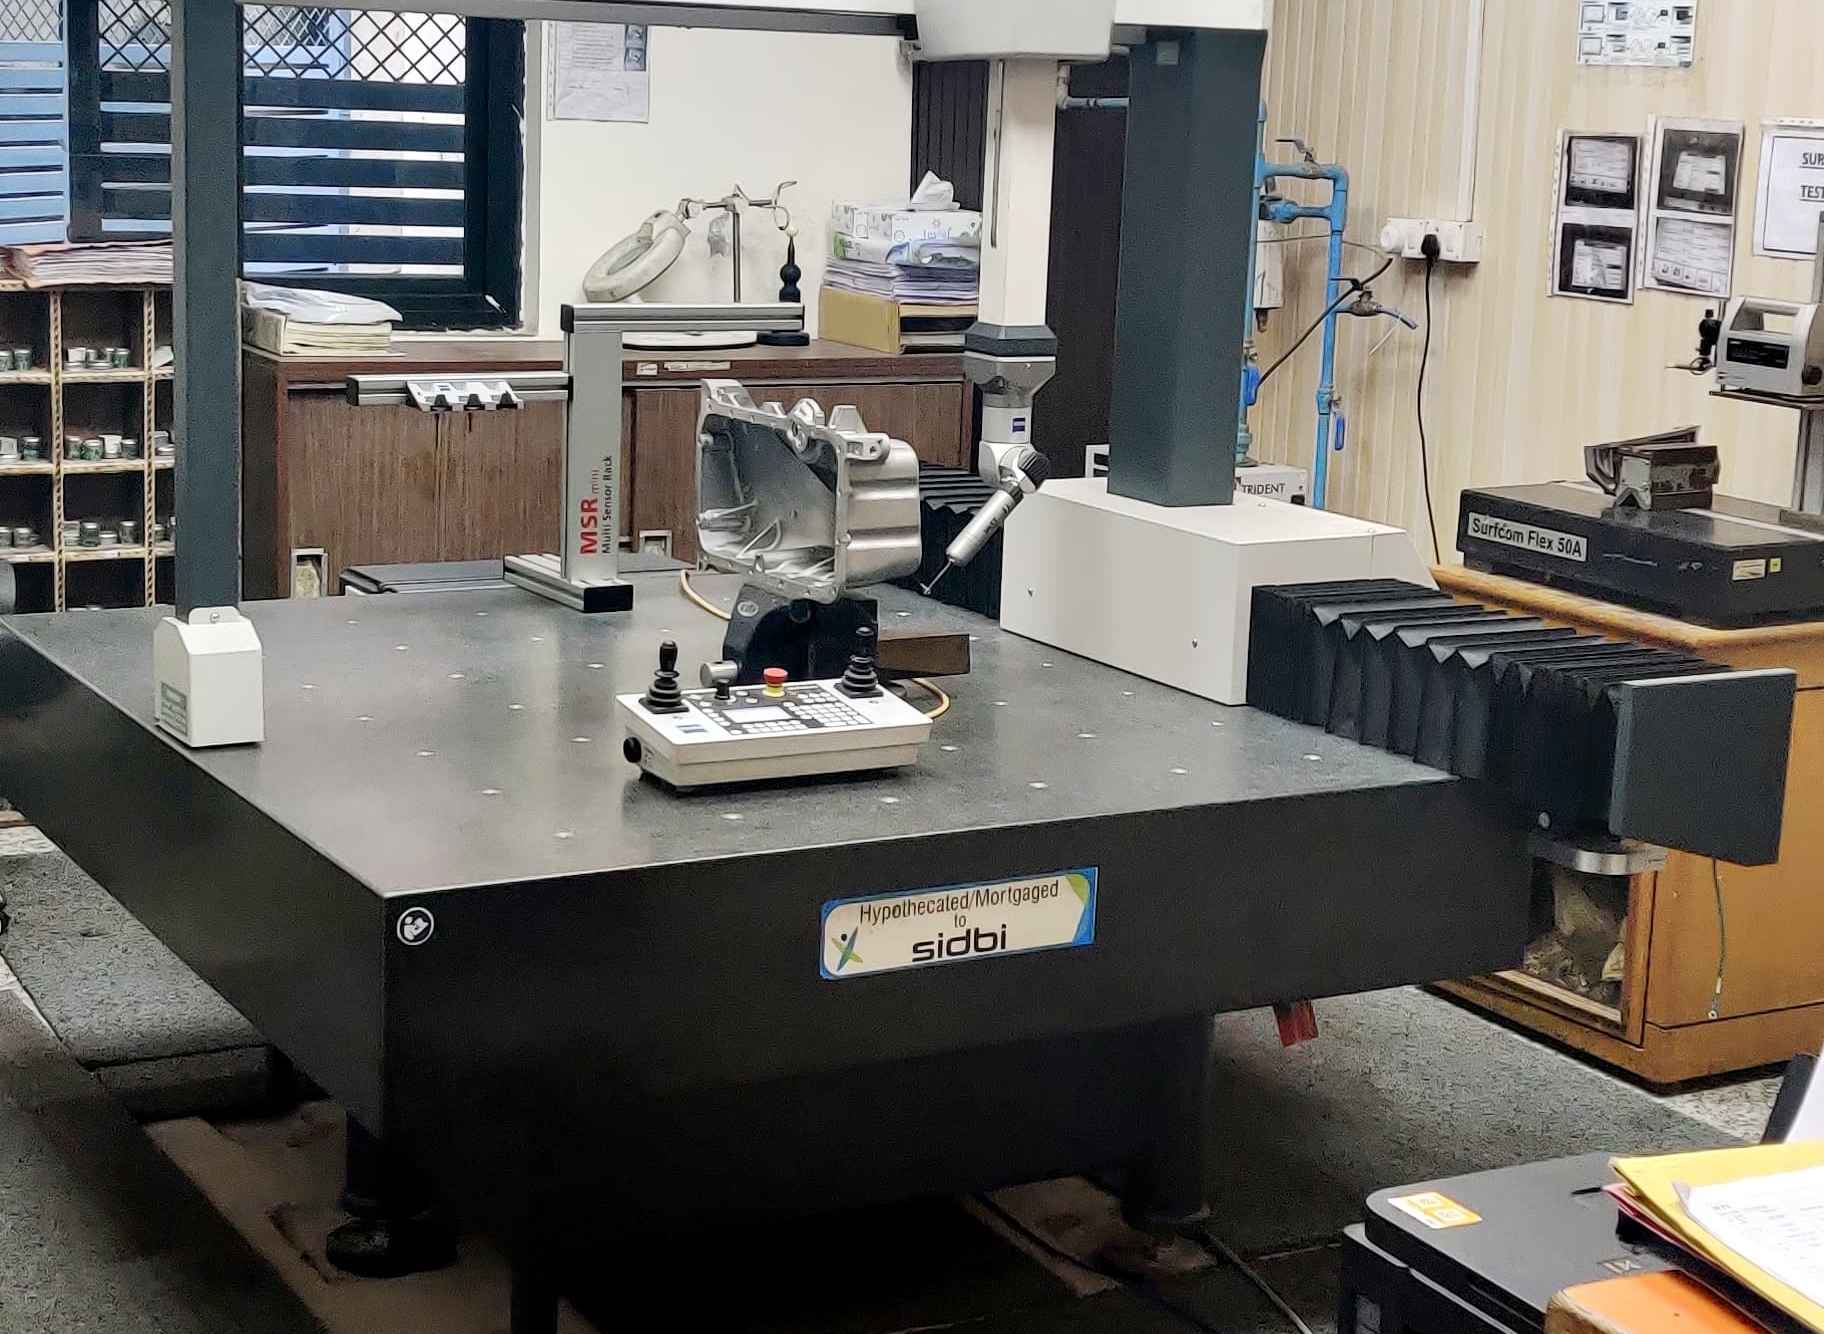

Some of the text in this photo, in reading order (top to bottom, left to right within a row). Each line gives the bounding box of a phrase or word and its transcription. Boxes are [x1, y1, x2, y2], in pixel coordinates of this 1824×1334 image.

[601, 455, 613, 554] Multi Sensor Rack
[1241, 482, 1286, 495] TRIDENT
[580, 469, 600, 555] MSR mini
[1472, 518, 1582, 558] Surfcom Flex 50A
[859, 879, 1059, 925] Hypothecated/Mortgaged
[953, 914, 967, 928] to
[911, 923, 1007, 963] sidbi
